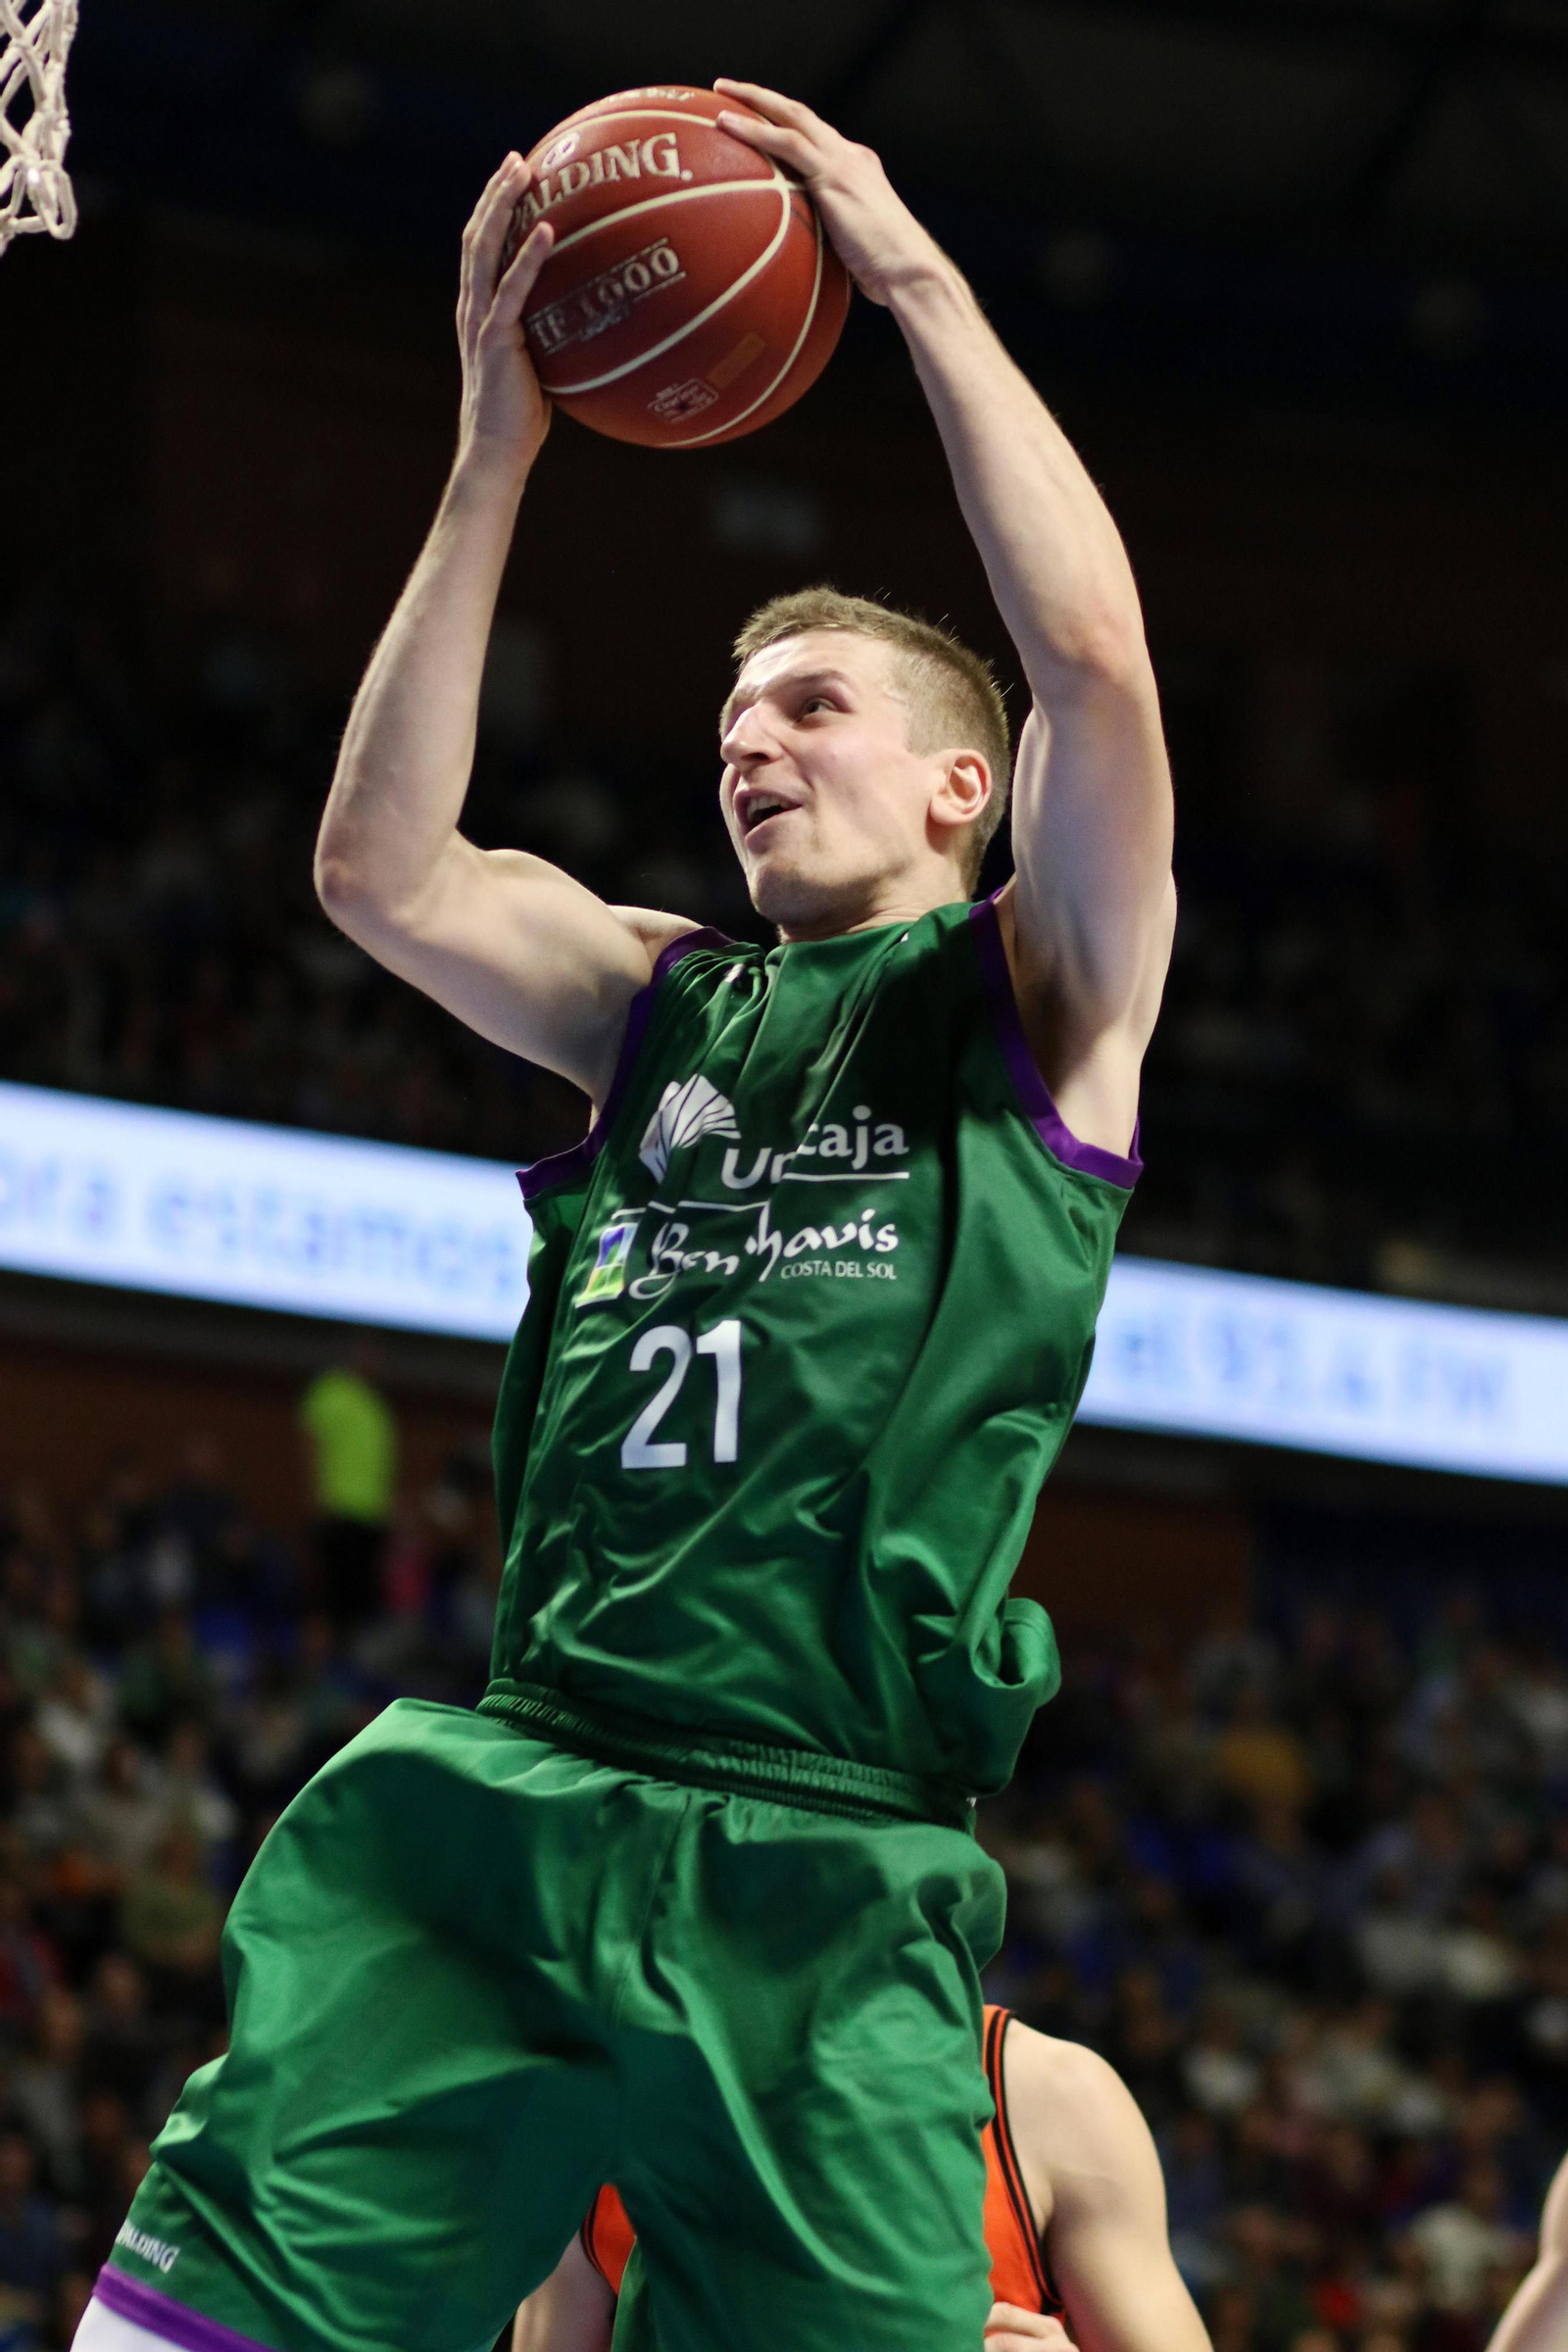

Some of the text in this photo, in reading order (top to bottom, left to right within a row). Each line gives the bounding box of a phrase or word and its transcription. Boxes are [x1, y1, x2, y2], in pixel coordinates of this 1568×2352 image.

[578, 246, 679, 321] 1000
[780, 1260, 897, 1281] COSTA DEL SOL
[621, 1319, 742, 1469] 21
